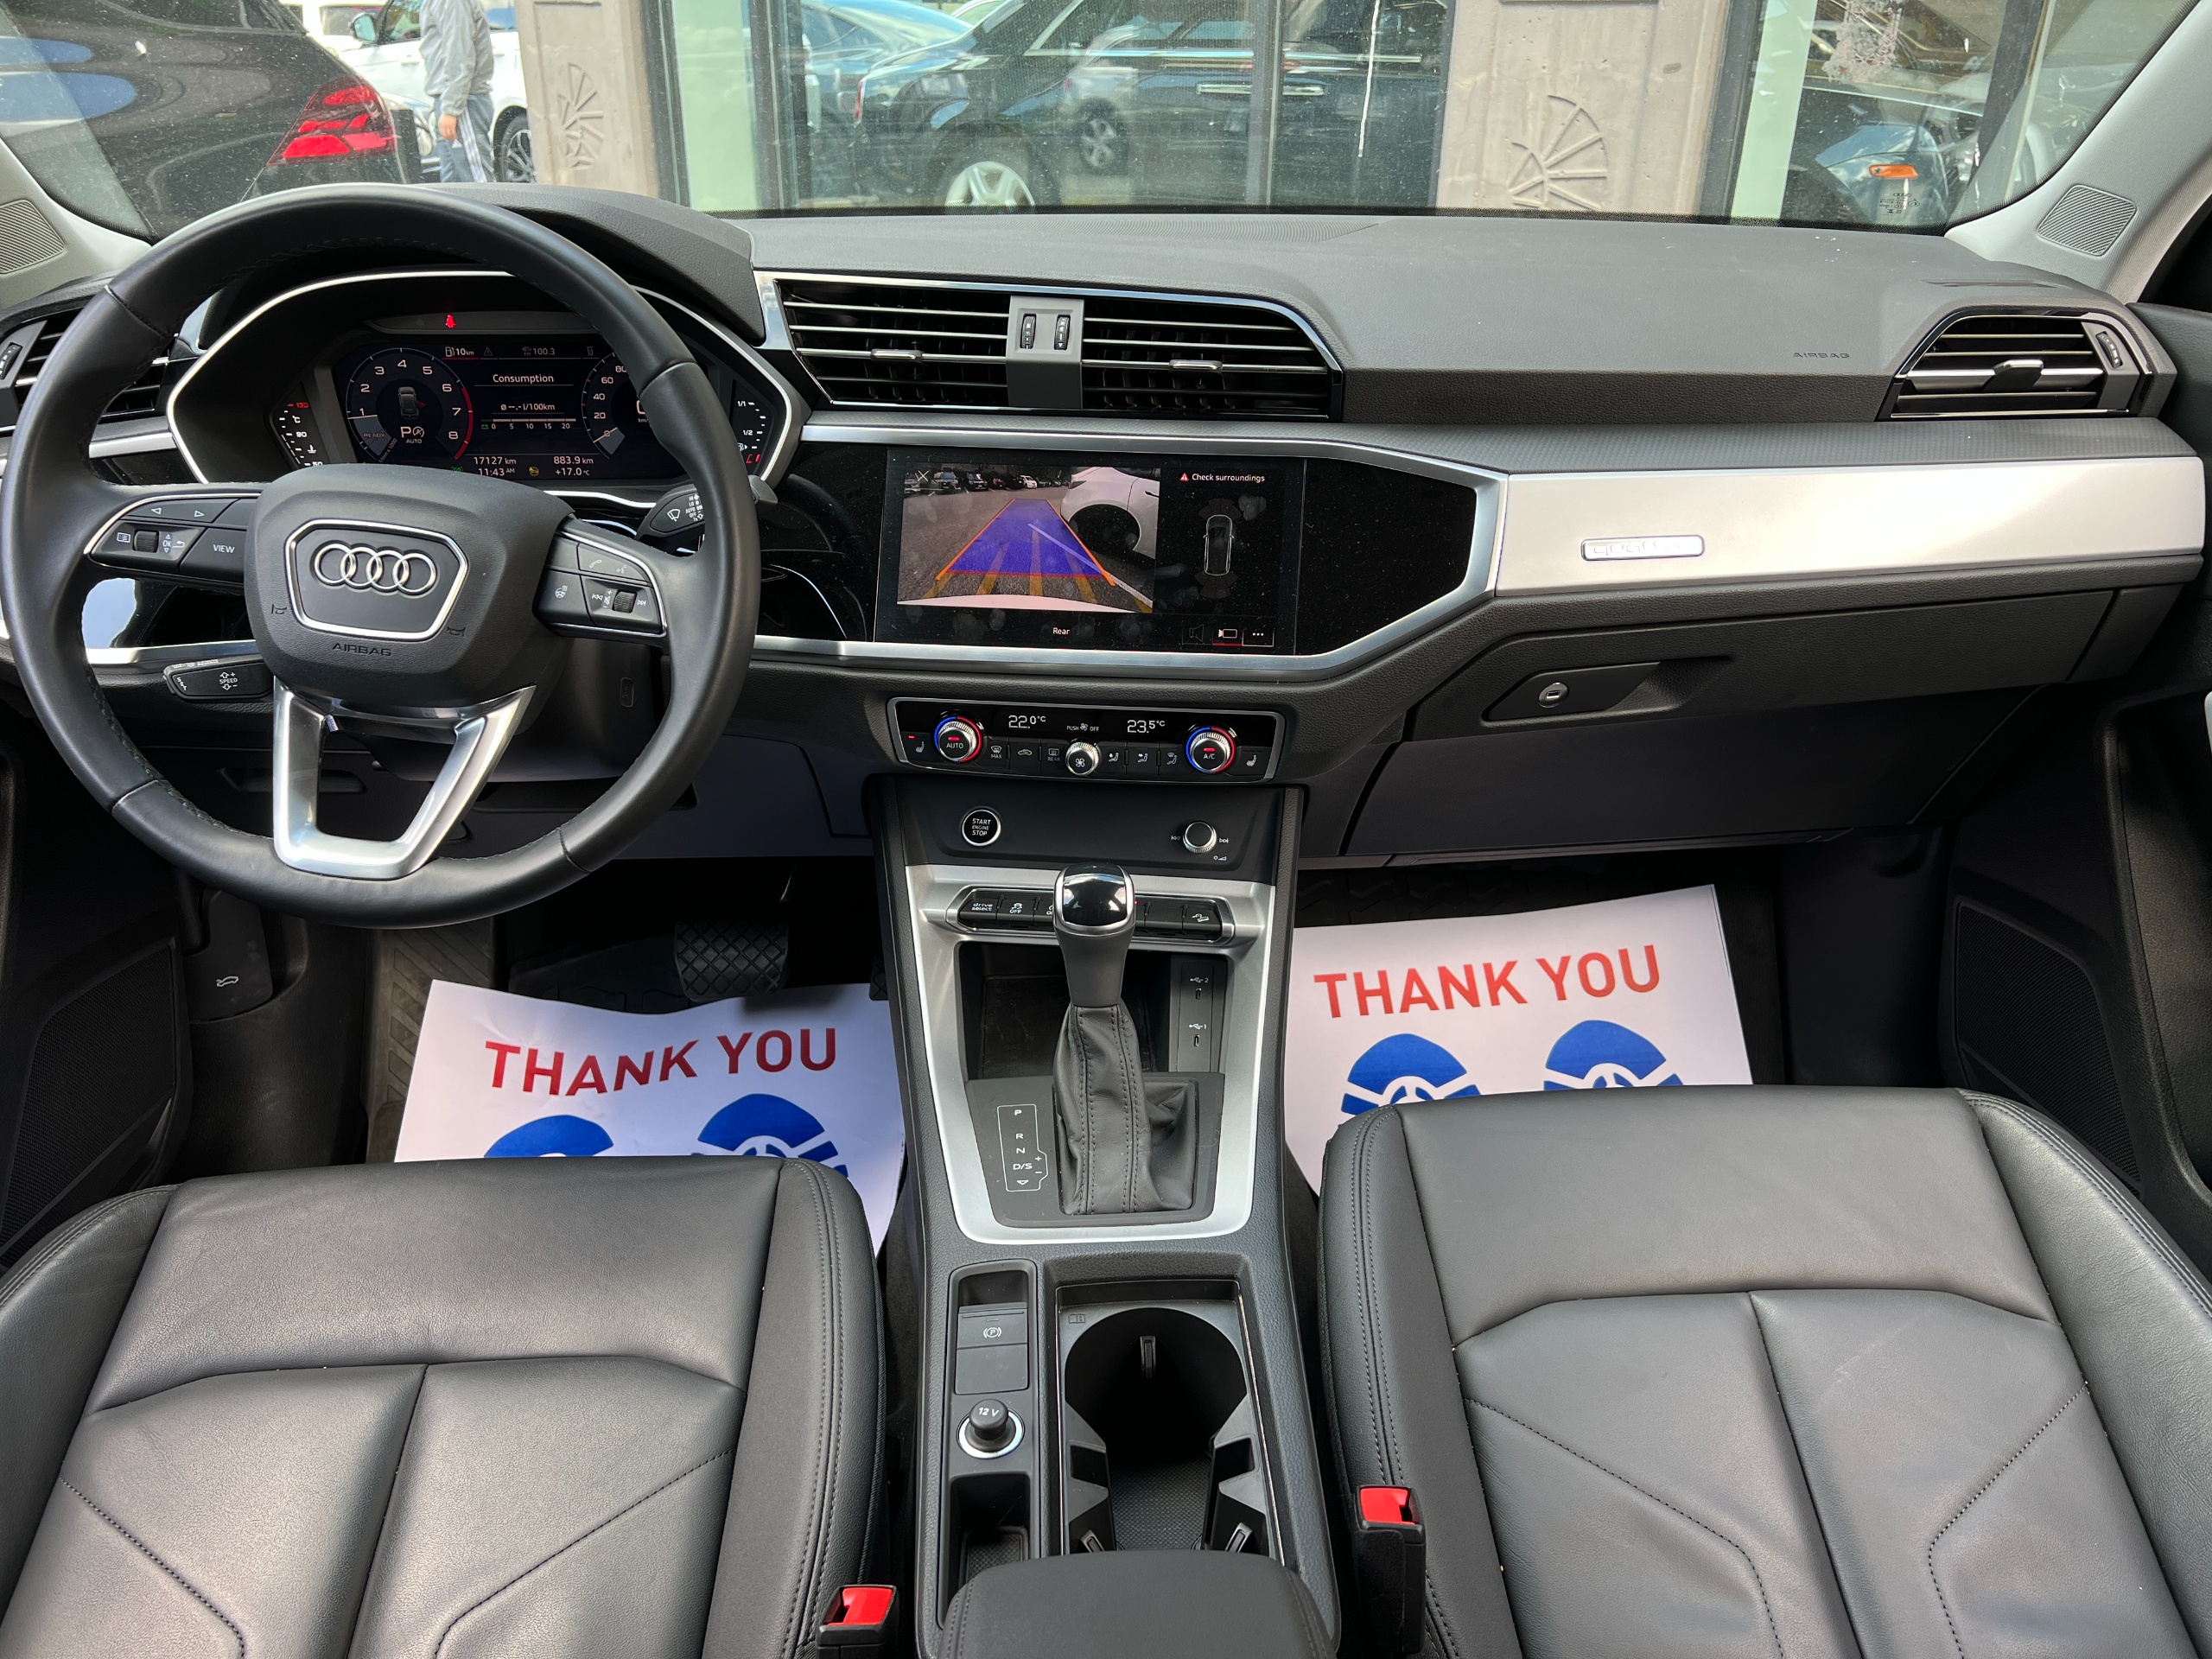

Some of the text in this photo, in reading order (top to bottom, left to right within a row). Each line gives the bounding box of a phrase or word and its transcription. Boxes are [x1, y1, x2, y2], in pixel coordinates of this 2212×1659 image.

[397, 359, 407, 368] 4
[374, 365, 385, 375] 3
[423, 365, 433, 375] 5
[493, 373, 555, 385] Consumption
[360, 384, 371, 392] 2
[442, 384, 452, 392] 6
[452, 408, 461, 416] 7
[400, 426, 411, 438] P
[448, 431, 459, 440] 8
[474, 456, 503, 465] 17127
[553, 456, 581, 465] 883.9
[478, 467, 505, 476] 11:43
[1192, 473, 1265, 483] Check surroundings
[213, 544, 235, 554] VIEW
[1052, 626, 1071, 635] Rear
[332, 642, 391, 657] AIRBAG
[176, 677, 188, 691] SET
[1313, 944, 1661, 1019] THANK YOU
[485, 1027, 836, 1096] THANK YOU
[978, 1407, 1000, 1417] 12 V
